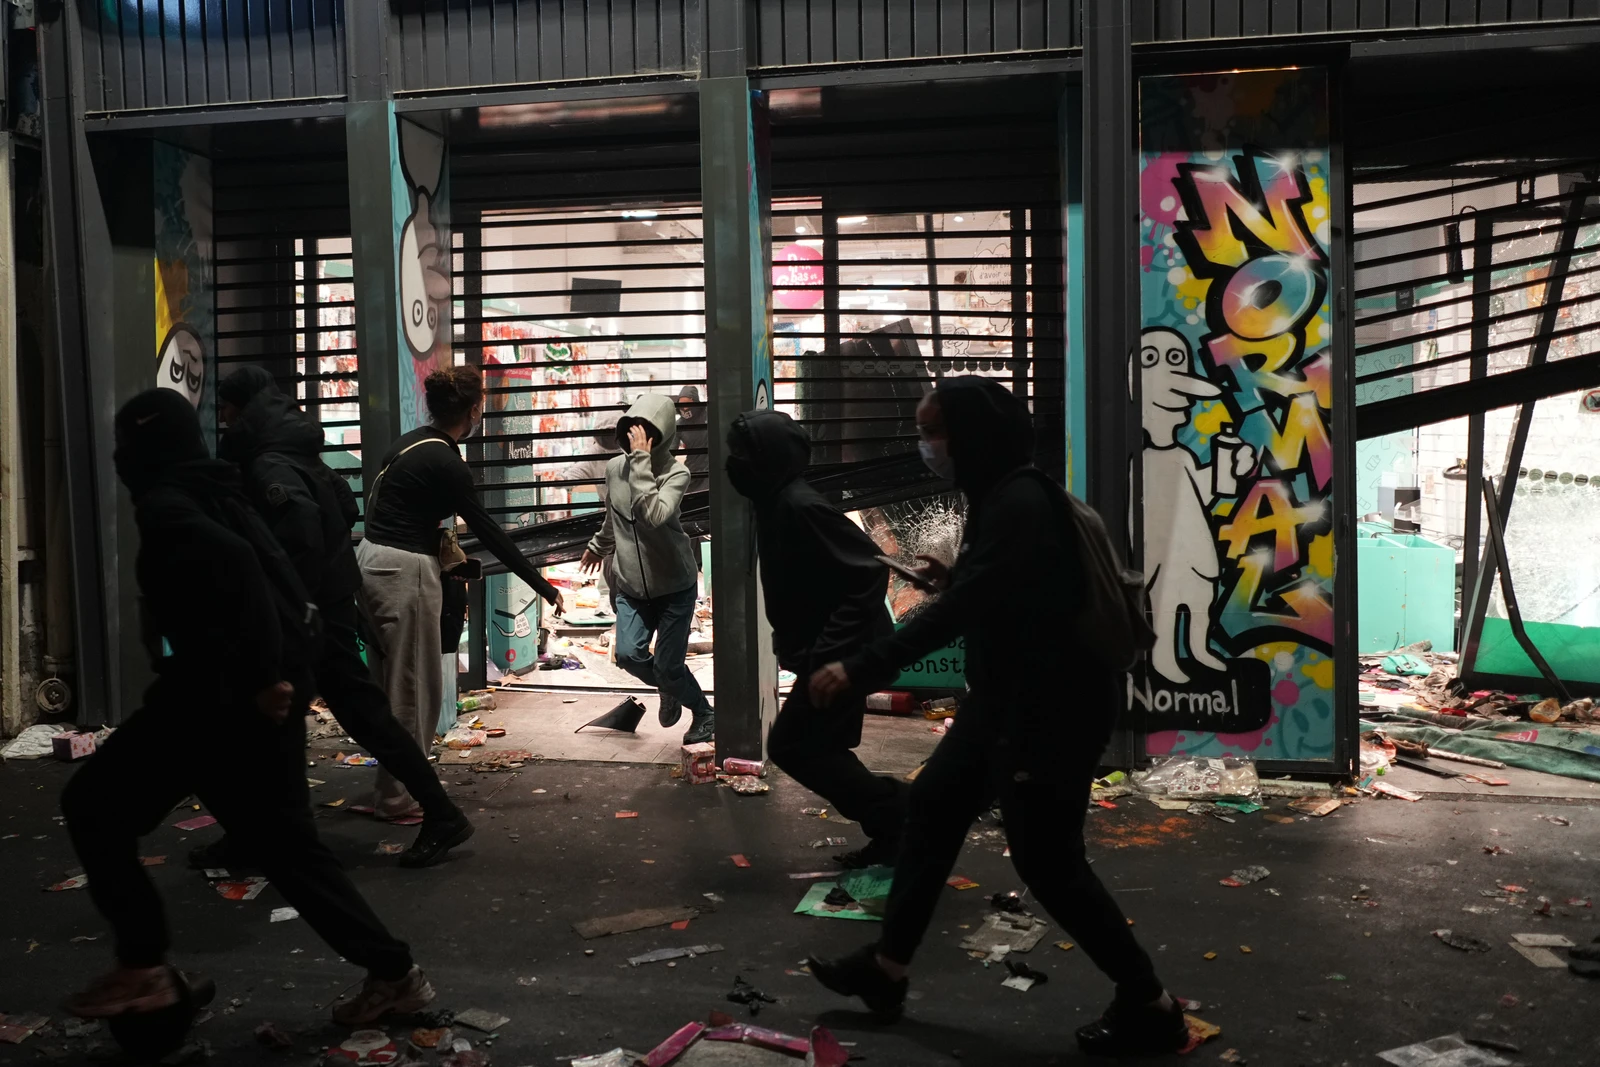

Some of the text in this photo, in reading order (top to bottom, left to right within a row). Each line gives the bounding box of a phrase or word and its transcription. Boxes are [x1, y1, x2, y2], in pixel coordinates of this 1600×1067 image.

[791, 266, 808, 283] bas
[1176, 148, 1332, 655] NORMAL
[1126, 672, 1240, 717] Normal
